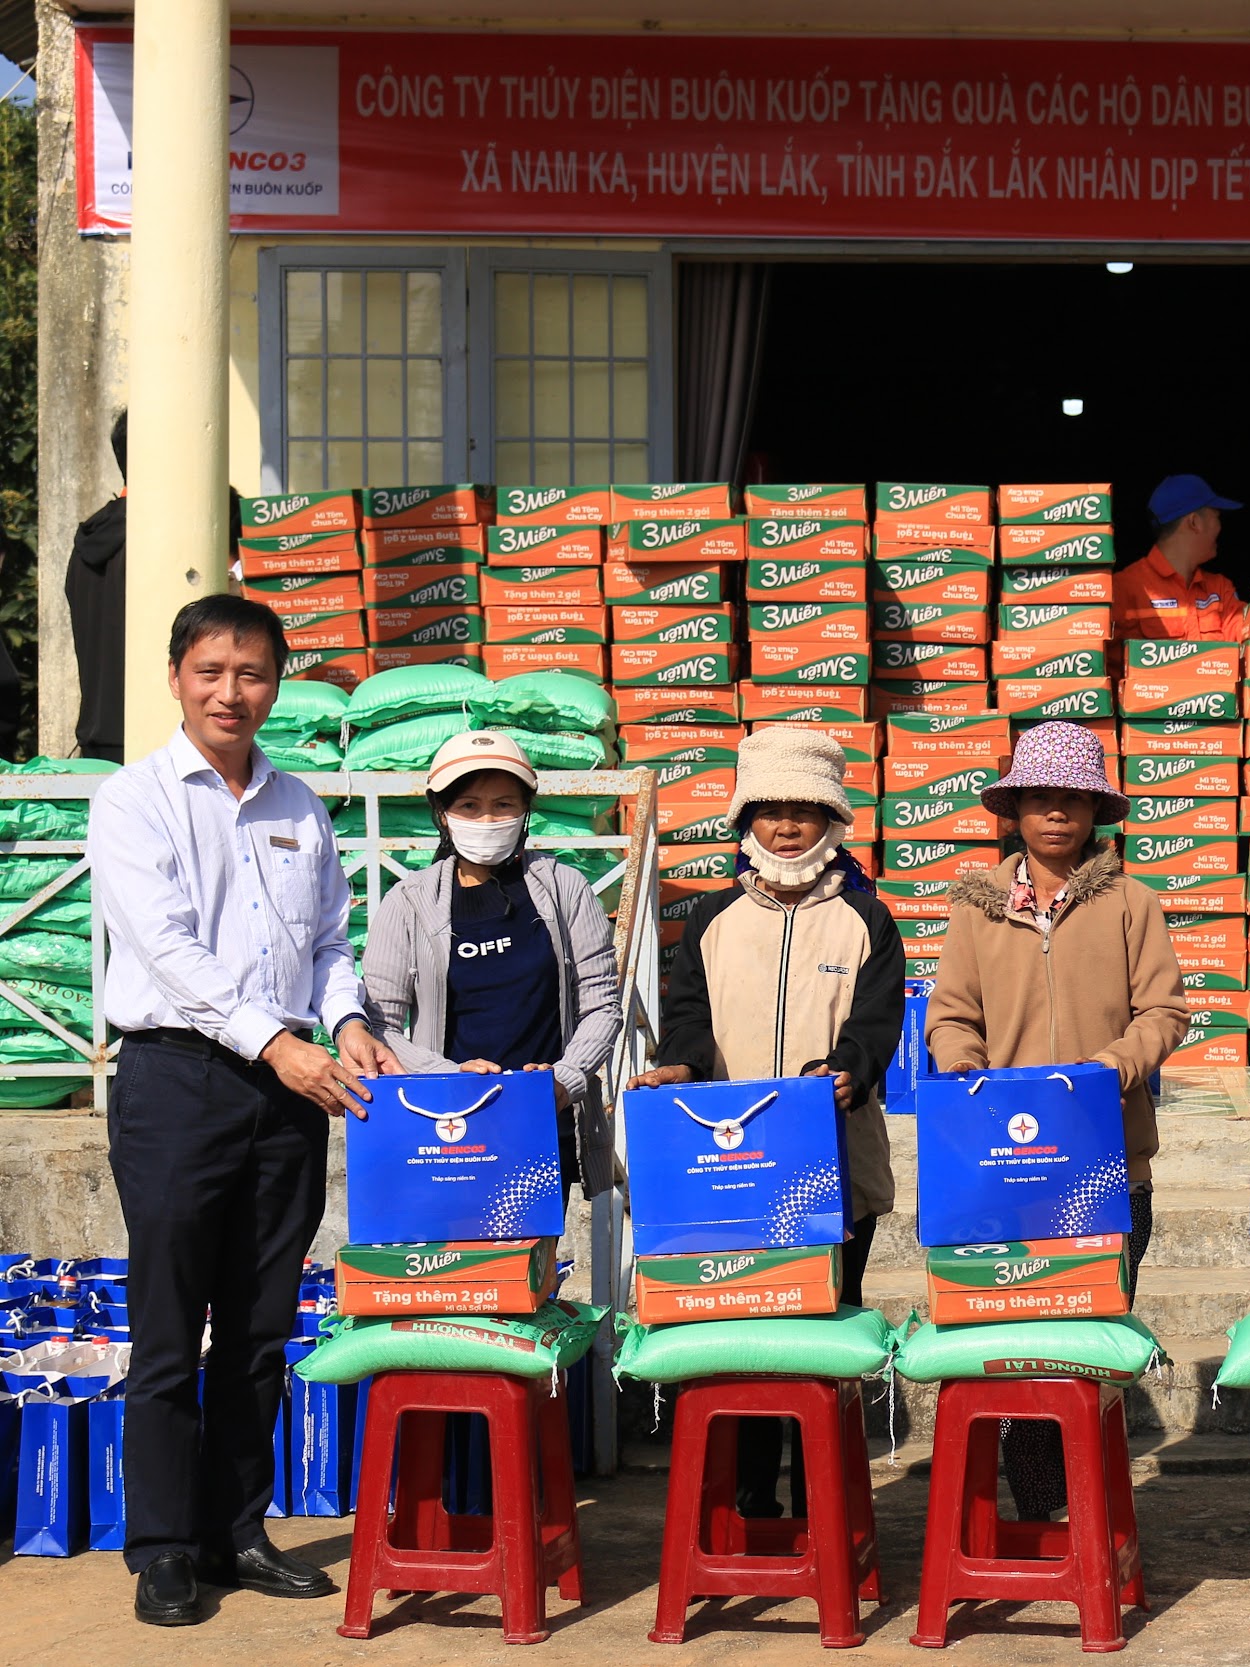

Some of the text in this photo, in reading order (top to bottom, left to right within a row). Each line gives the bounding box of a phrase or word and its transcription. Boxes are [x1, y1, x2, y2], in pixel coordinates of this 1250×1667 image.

[356, 66, 444, 119] CÔNG
[453, 76, 489, 119] TY
[500, 66, 580, 120] THỦY
[589, 70, 660, 130] ĐIỆN
[669, 70, 756, 121] BUÔN
[766, 66, 851, 122] KUỐP
[859, 73, 942, 130] TẶNG
[953, 74, 1016, 126] QUÀ
[1027, 73, 1089, 125] CÁC
[1099, 75, 1142, 135] HỘ
[1152, 75, 1213, 126] DÂN
[460, 146, 502, 193] XÃ
[511, 152, 577, 193] NAM
[587, 151, 638, 201] KA,
[648, 143, 749, 205] HUYỆN
[761, 137, 829, 204] LẮK,
[837, 142, 905, 199] TỈNH
[914, 138, 976, 199] ĐẮK
[988, 138, 1048, 199] LẮK
[1057, 147, 1141, 201] NHÂN
[1151, 157, 1198, 212] DỊP
[245, 182, 281, 195] BUÔN
[286, 181, 323, 196] KUỐP
[315, 511, 344, 520] Mì Tôm
[333, 518, 348, 526] Cay
[819, 589, 857, 598] Chua Cay
[824, 581, 853, 589] Mì Tôm
[912, 740, 991, 751] Tặng thêm 2 gói
[457, 936, 512, 958] OFF
[373, 1288, 498, 1305] Tặng thêm 2 gói
[676, 1288, 802, 1310] Tặng thêm 2 gói
[966, 1291, 1092, 1312] Tặng thêm 2 gói
[412, 1320, 478, 1338] HƯƠNG
[483, 1331, 514, 1347] LÀI
